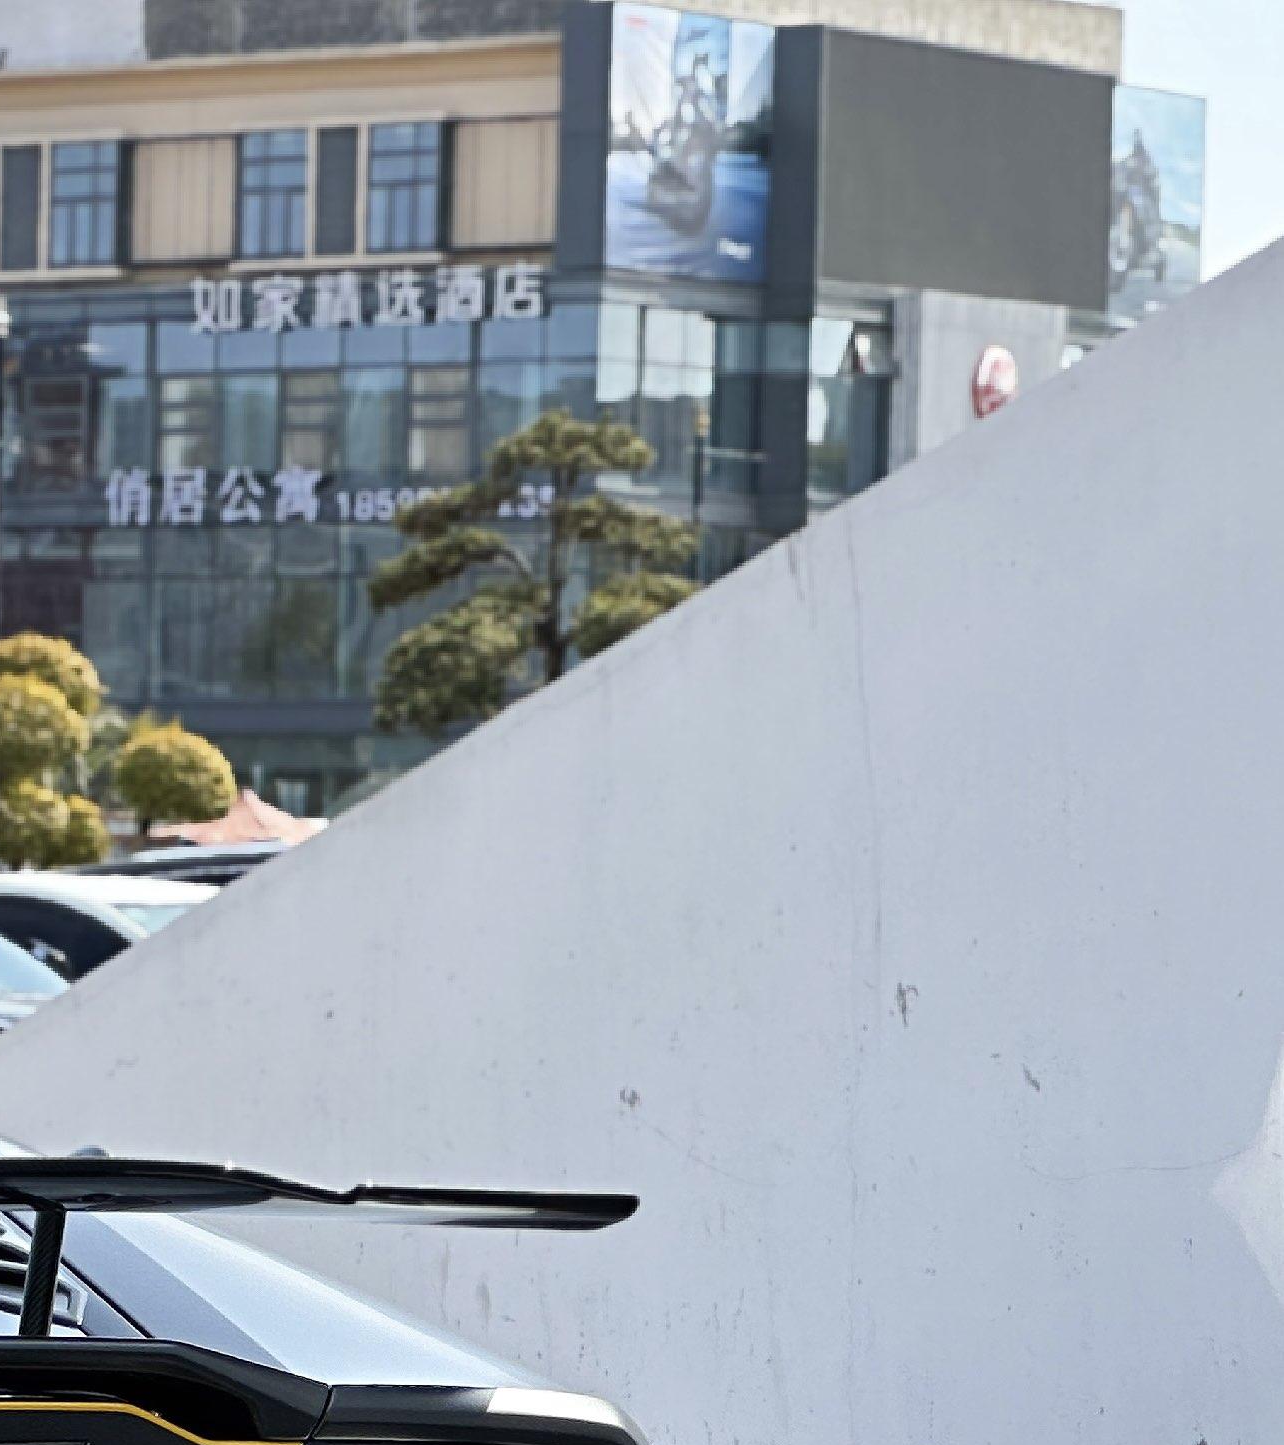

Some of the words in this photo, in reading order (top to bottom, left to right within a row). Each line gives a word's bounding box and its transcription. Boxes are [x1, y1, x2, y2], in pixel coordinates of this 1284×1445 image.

[190, 262, 546, 334] 如家精选酒店
